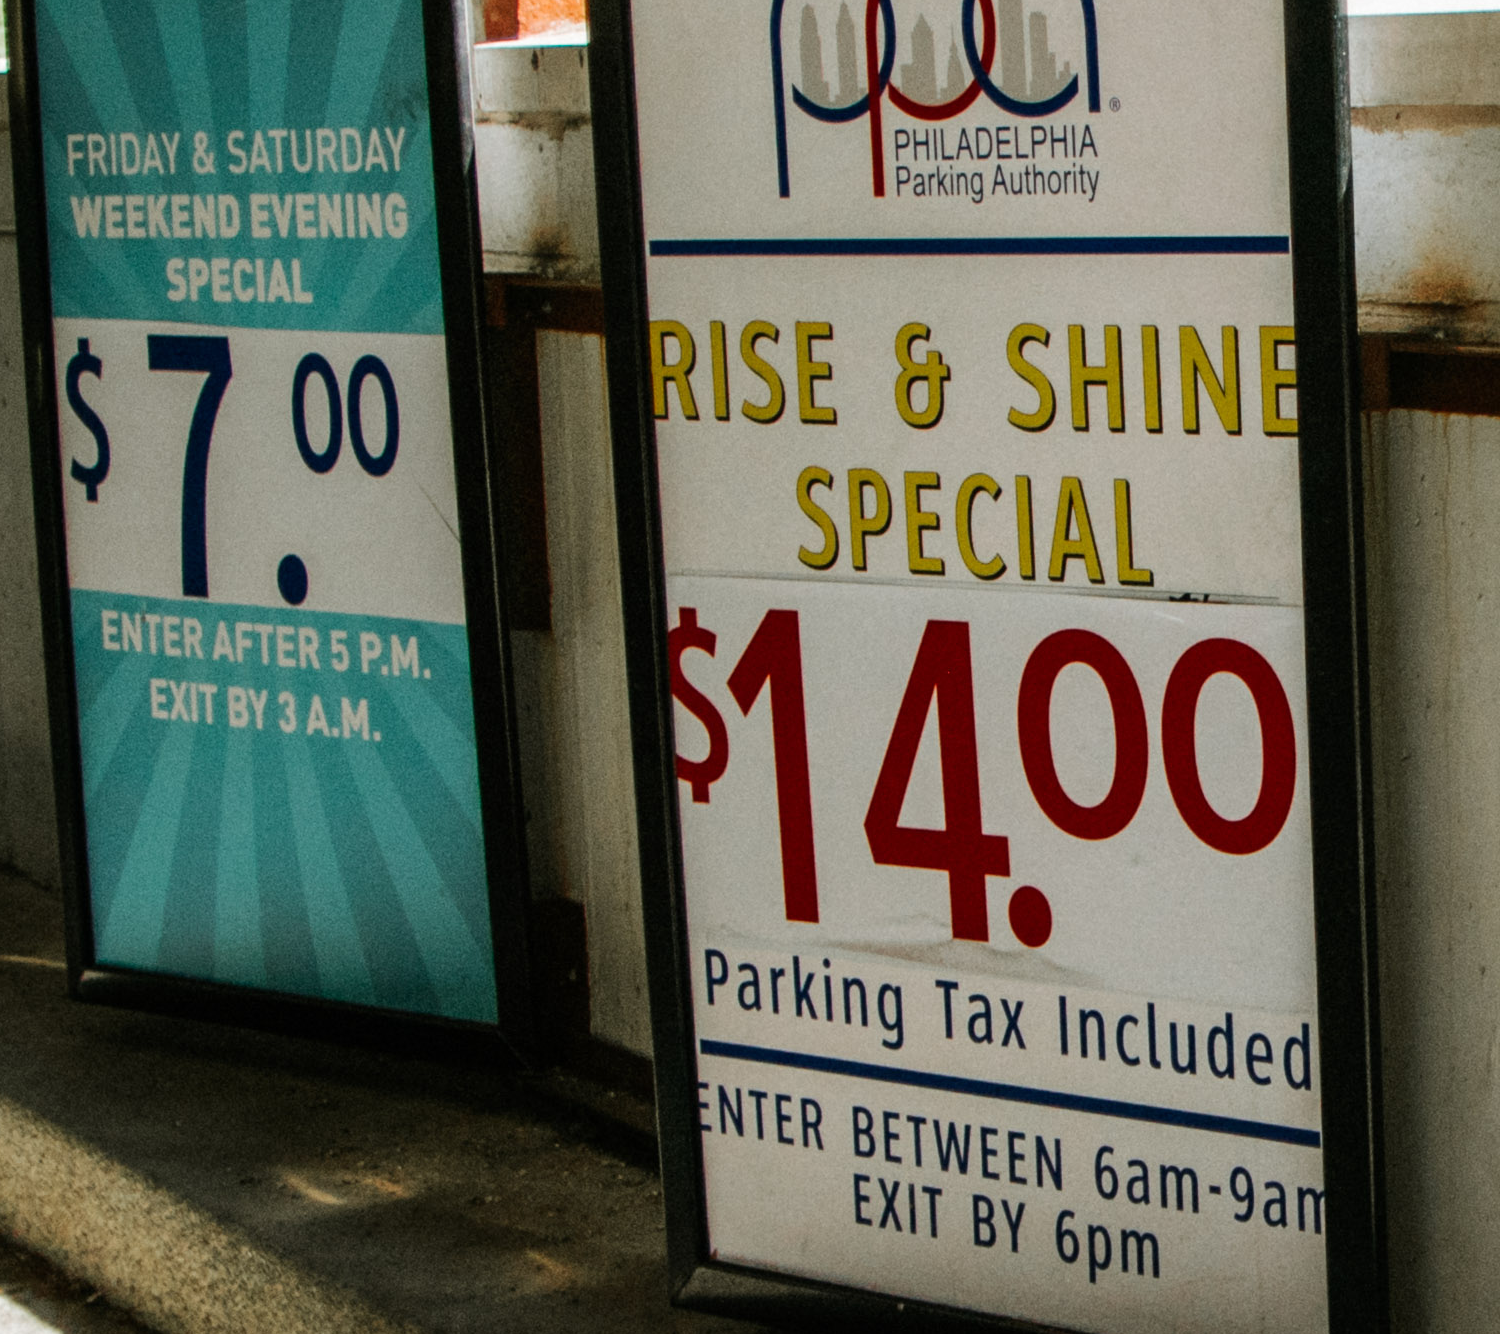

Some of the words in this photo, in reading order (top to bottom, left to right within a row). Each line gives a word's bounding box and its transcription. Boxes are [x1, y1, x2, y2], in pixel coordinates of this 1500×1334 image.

[66, 131, 181, 177] FRIDAY
[192, 130, 216, 175] &
[227, 126, 407, 175] SATURDAY
[894, 124, 1099, 163] PHILADELPHIA
[70, 193, 241, 240] WEEKEND
[251, 191, 409, 241] EVENING
[895, 163, 985, 205] Parking
[991, 163, 1101, 204] Authority
[165, 257, 313, 304] SPECIAL
[649, 319, 838, 425] RISE
[893, 322, 951, 430] &
[1006, 322, 1301, 437] SHINE
[796, 465, 1154, 587] SPECIAL
[101, 609, 204, 661] ENTER
[212, 618, 320, 670] AFTER
[328, 628, 351, 673] 5
[359, 631, 432, 681] P.M.
[149, 678, 220, 725] EXIT
[226, 686, 269, 734] BY
[277, 692, 299, 737] 3
[305, 694, 382, 743] A.M.
[703, 947, 906, 1052] Parking
[934, 978, 1027, 1051] Tax
[1058, 994, 1313, 1092] Included
[853, 1105, 1064, 1193] BETWEEN
[1094, 1144, 1328, 1236] 6am-9am
[853, 1173, 943, 1239] EXIT
[972, 1195, 1027, 1255] BY
[1054, 1210, 1161, 1284] 6pm
